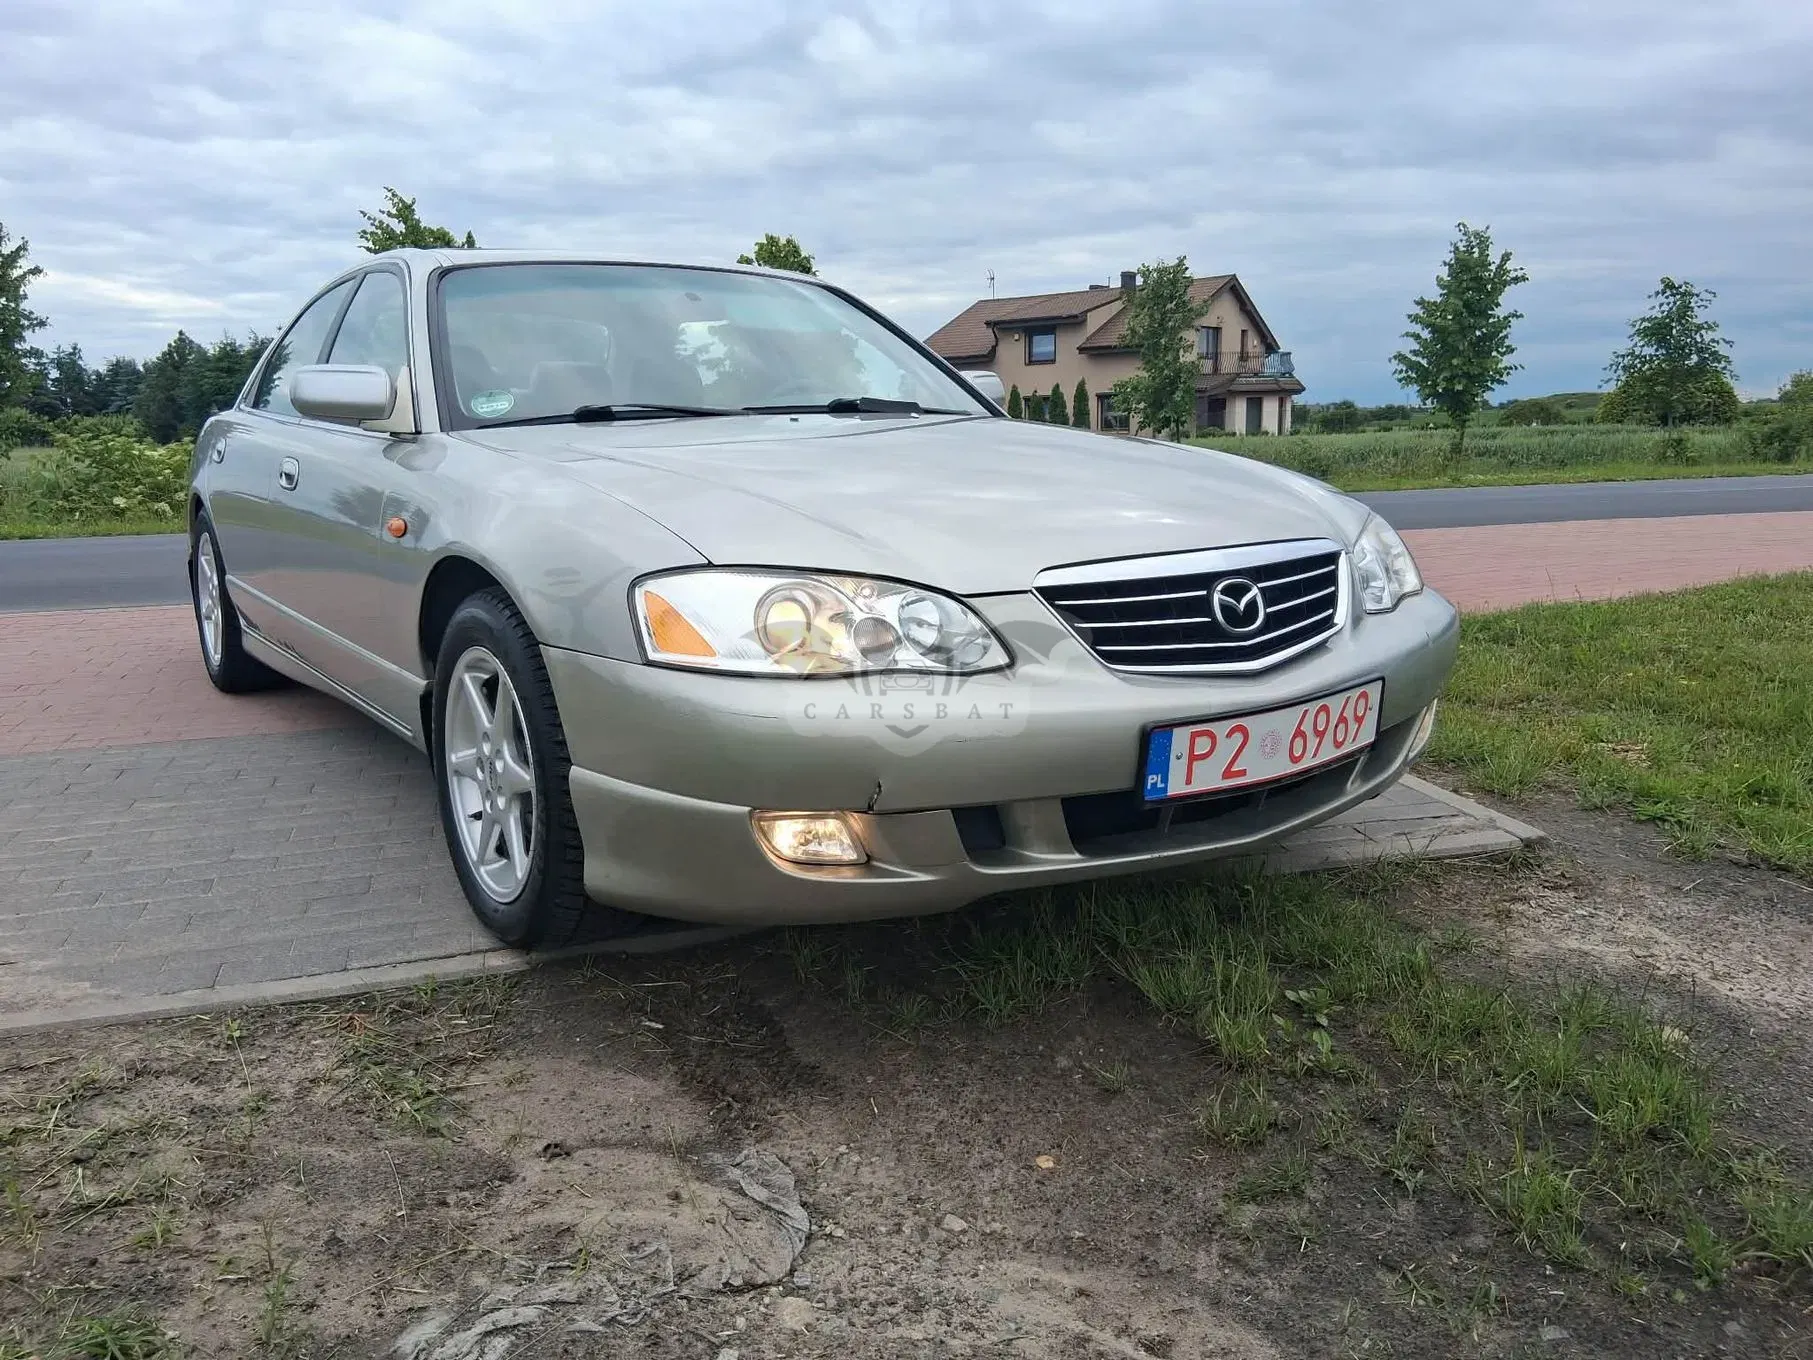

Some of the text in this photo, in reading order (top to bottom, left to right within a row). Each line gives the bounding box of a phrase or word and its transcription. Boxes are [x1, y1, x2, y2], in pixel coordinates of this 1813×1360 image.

[1184, 690, 1369, 785] P2 6969
[1147, 774, 1165, 789] PL
